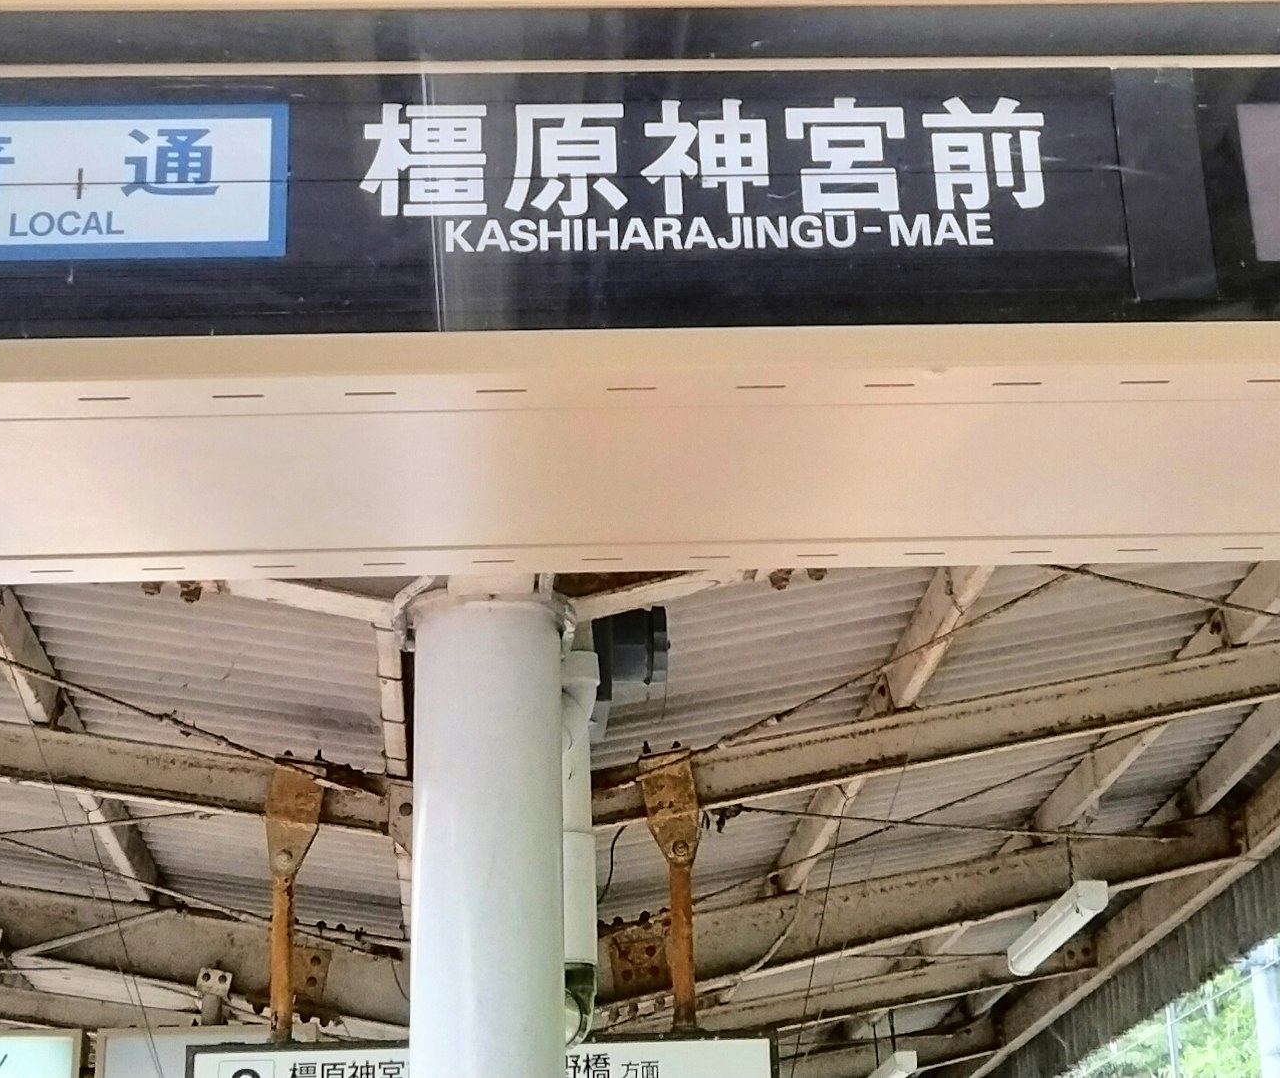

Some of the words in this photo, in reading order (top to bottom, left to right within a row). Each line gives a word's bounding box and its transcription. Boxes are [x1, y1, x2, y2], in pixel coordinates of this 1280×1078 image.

[359, 96, 1046, 217] 橿原神宮前
[8, 209, 126, 238] LOCAL
[288, 1059, 410, 1078] 橿原神宮
[621, 1060, 660, 1078] 方面
